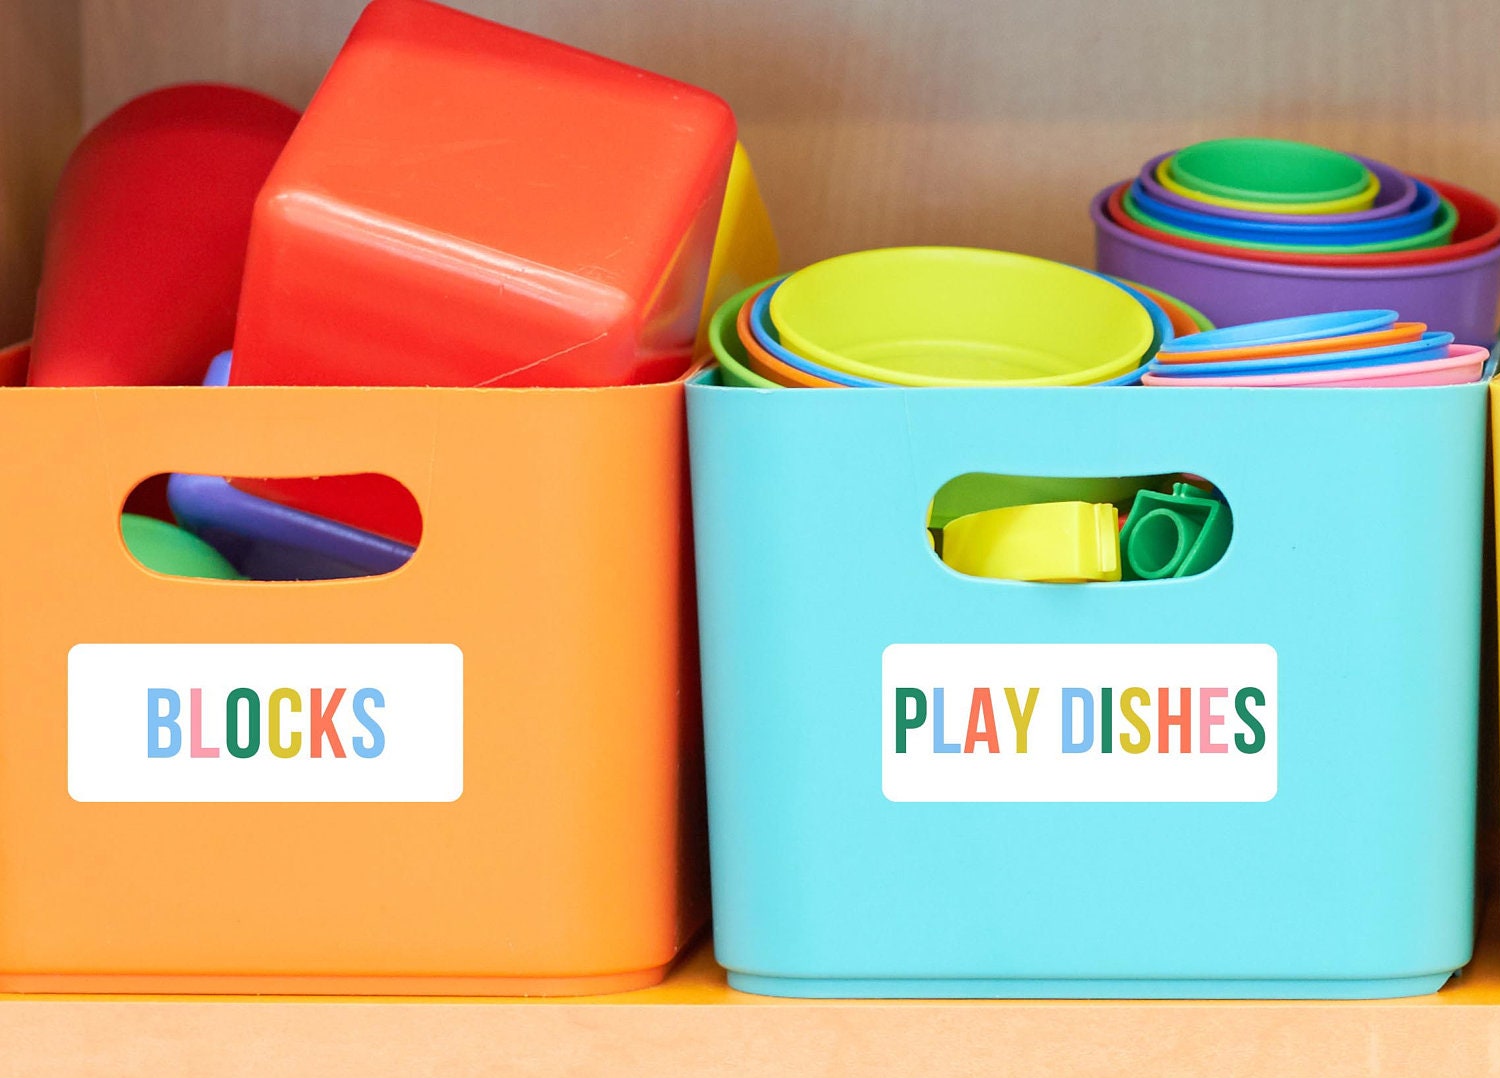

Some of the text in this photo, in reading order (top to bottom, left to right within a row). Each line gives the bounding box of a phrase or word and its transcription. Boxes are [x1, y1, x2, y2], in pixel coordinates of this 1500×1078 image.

[147, 686, 386, 760] BLOCKS
[894, 686, 1267, 756] PLAY DISHES
